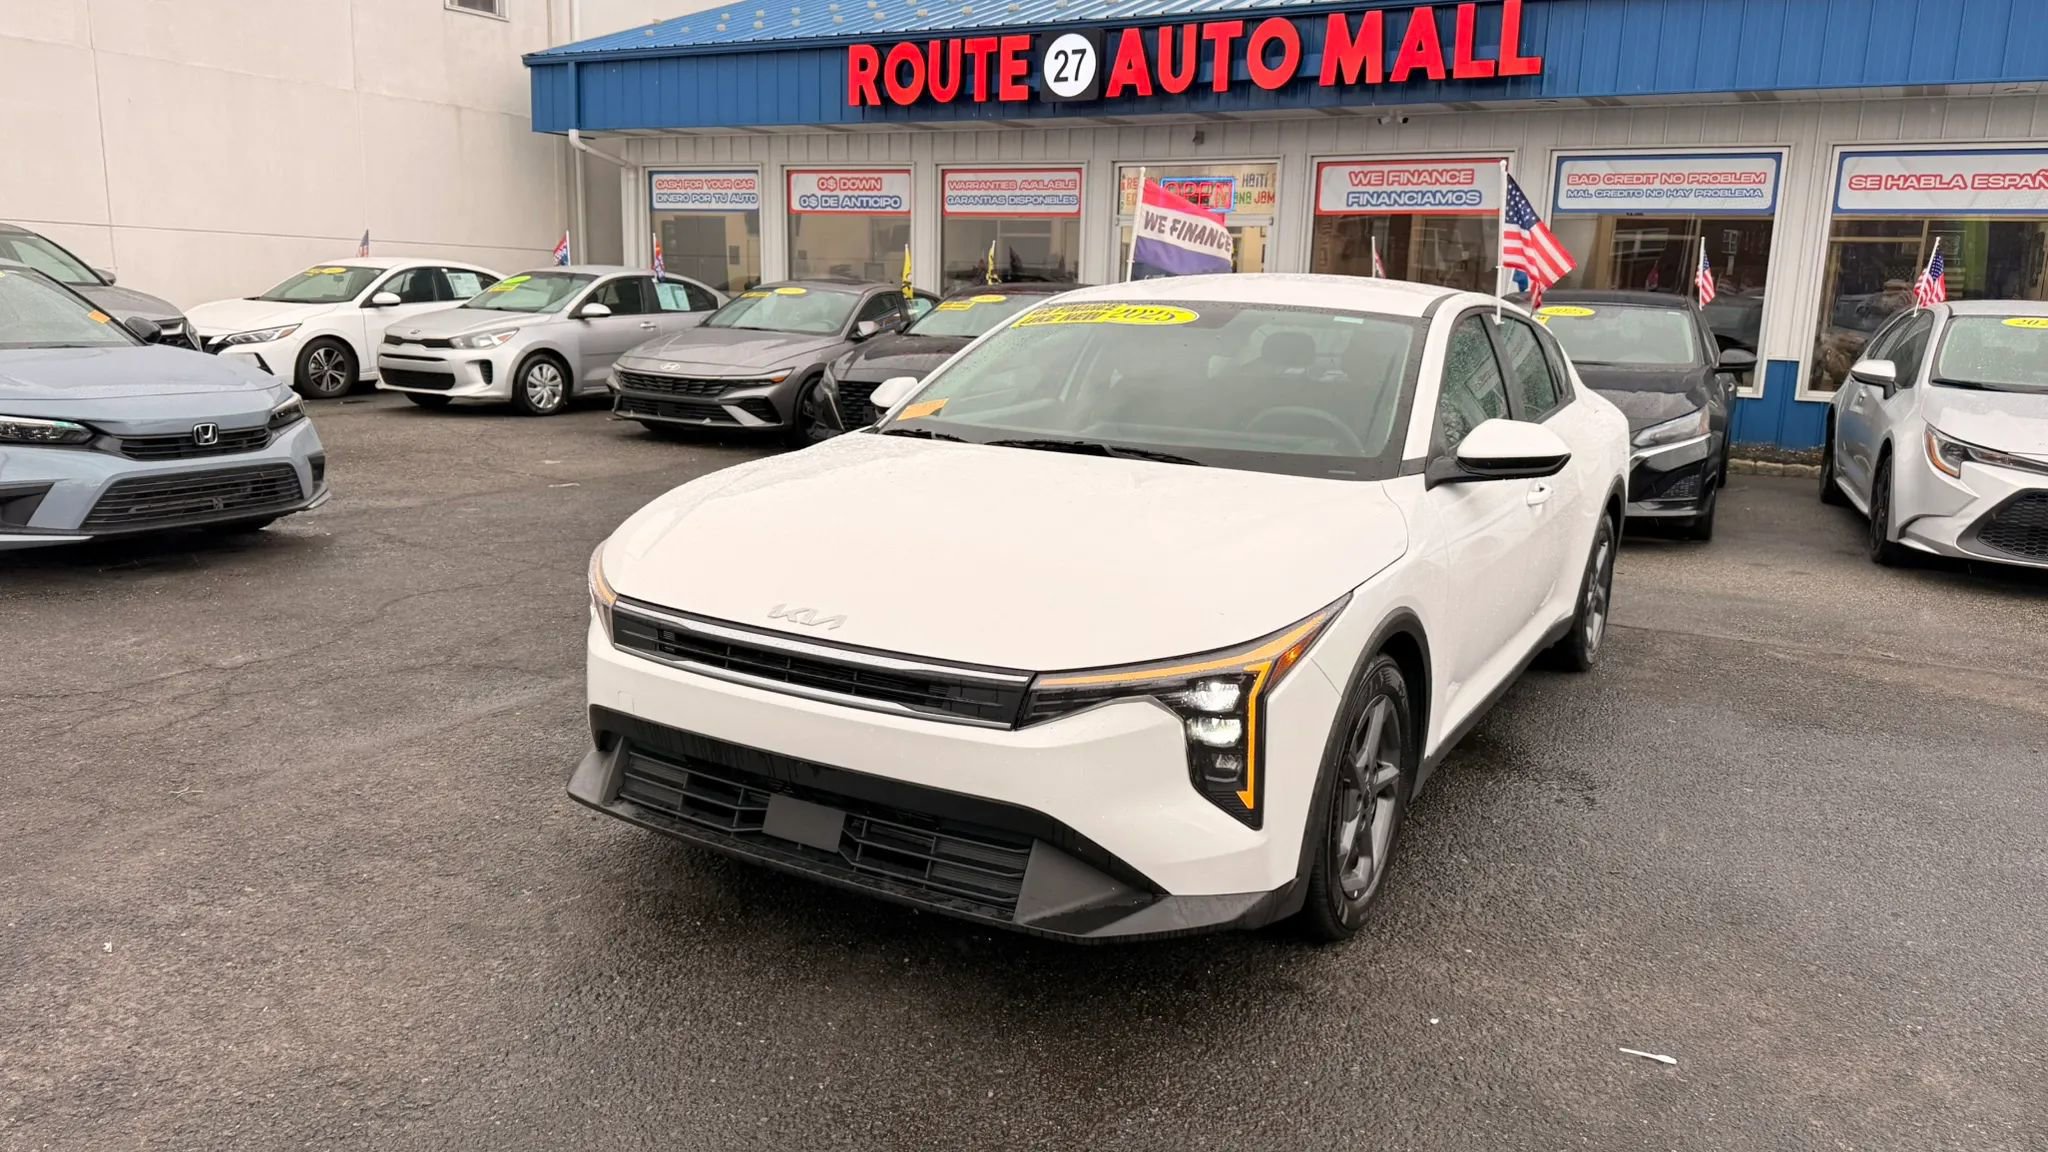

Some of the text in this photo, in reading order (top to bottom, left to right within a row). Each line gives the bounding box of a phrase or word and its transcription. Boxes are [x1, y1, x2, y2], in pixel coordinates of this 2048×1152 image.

[848, 0, 1542, 106] ROUTE 27 AUTO MALL
[655, 179, 756, 190] CASH FOR YOUR CAR
[839, 178, 882, 191] DOWN
[947, 179, 1077, 190] WARRANTIES AVAILABLE
[1349, 169, 1475, 187] WE FINANCE
[1567, 172, 1767, 185] BAD CREDIT NO PROBLEM
[1848, 175, 1881, 190] SE
[1883, 174, 1968, 190] HABLA
[655, 193, 758, 203] DINERO POR TU AUTO
[1346, 190, 1482, 207] FINANCIAMOS
[1566, 188, 1764, 198] MAL CREDITO NO HAY PROBLEMA
[820, 195, 840, 208] DE
[841, 195, 902, 209] ANTICIPO
[946, 195, 1078, 205] GARANTIAS DISPONIBLES
[1144, 211, 1232, 253] WE FINANCE
[1060, 312, 1107, 322] NEW
[1108, 309, 1176, 322] 2025
